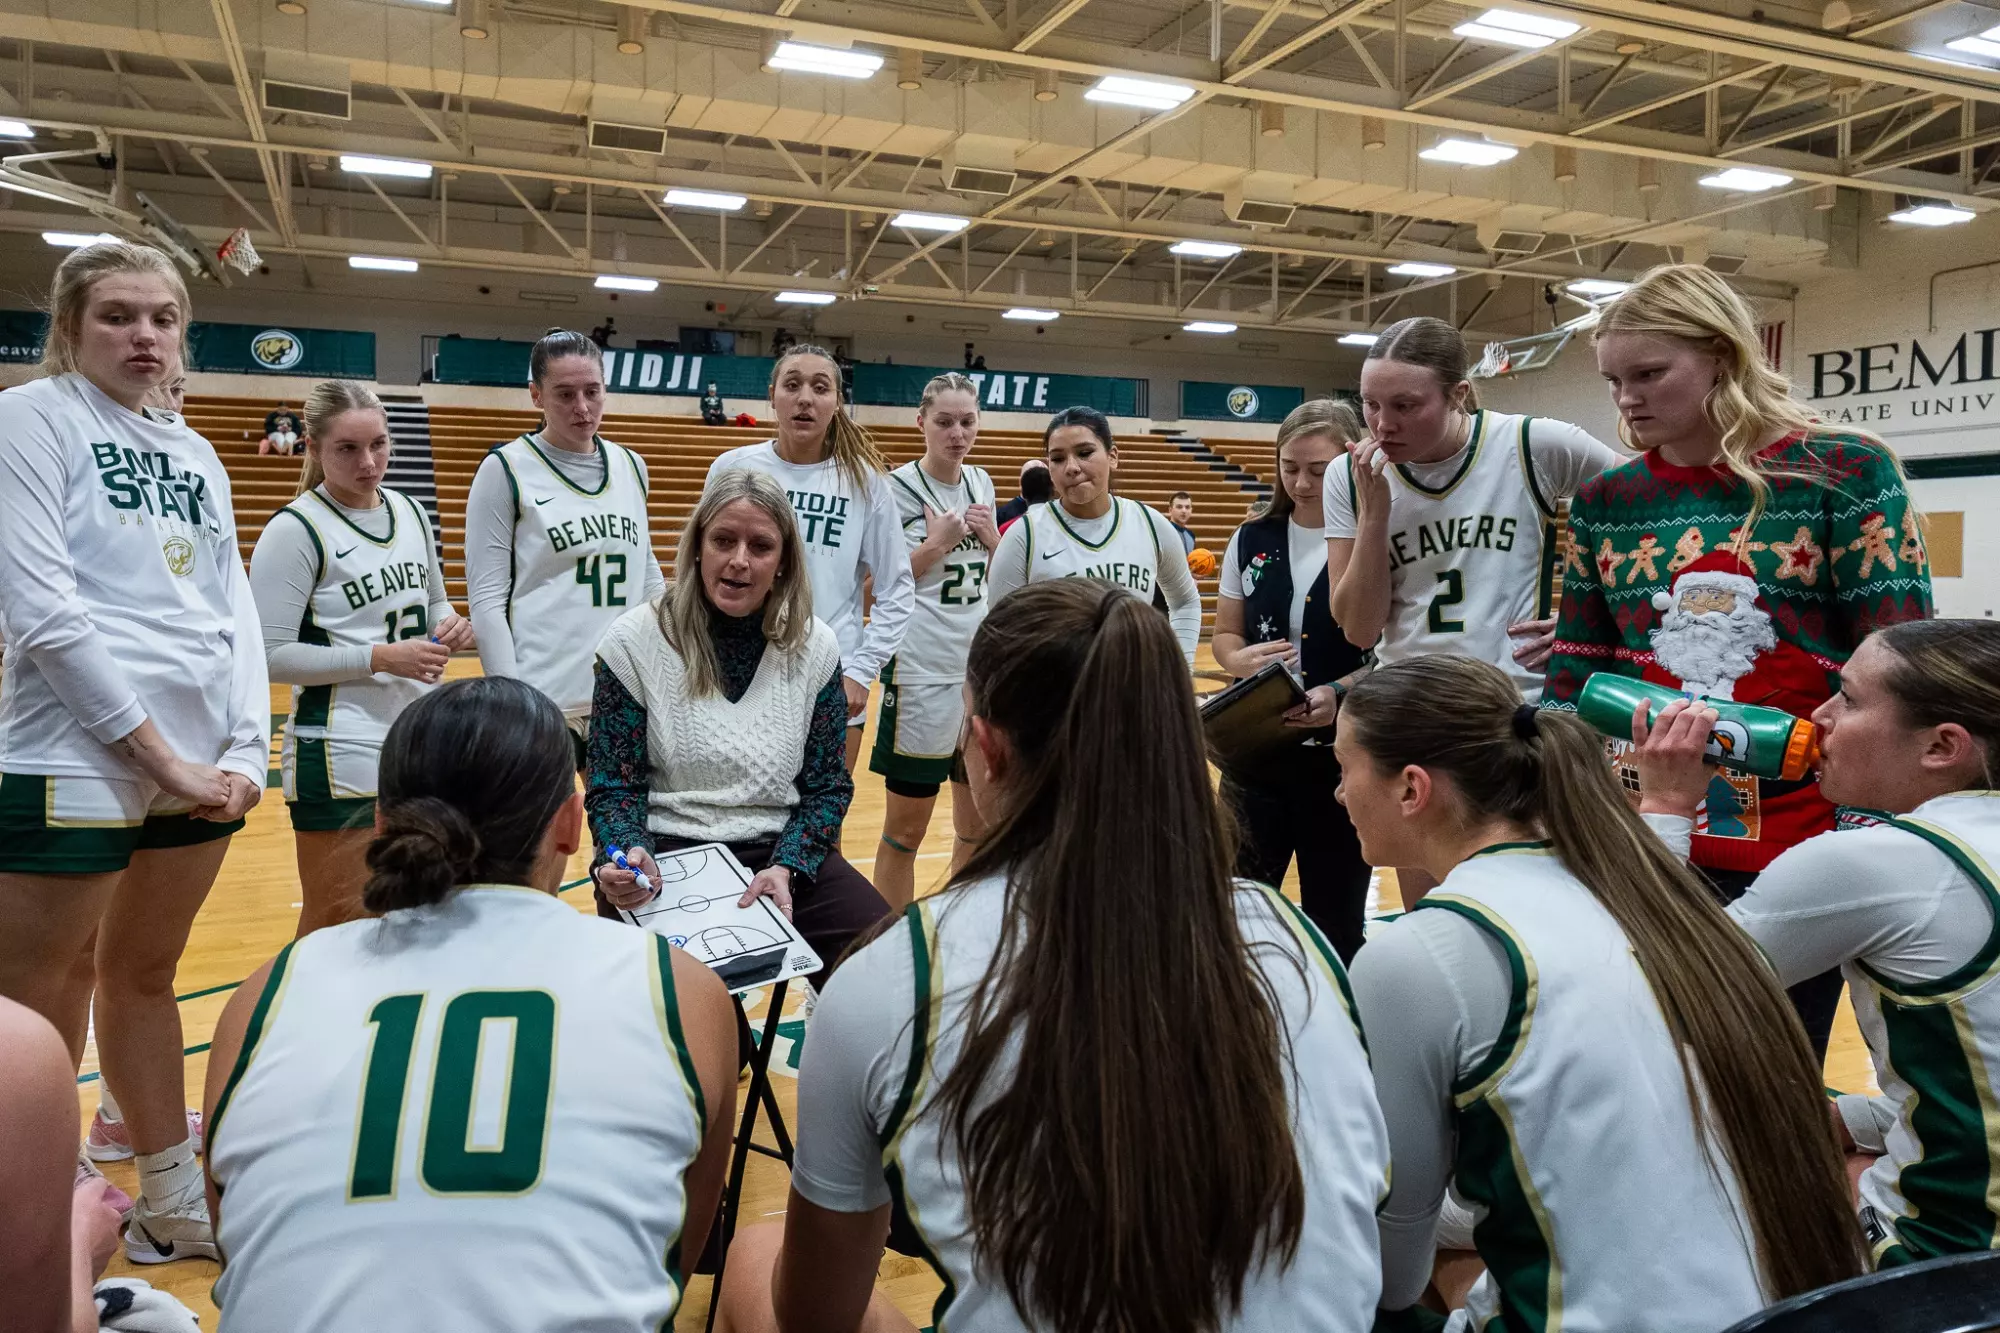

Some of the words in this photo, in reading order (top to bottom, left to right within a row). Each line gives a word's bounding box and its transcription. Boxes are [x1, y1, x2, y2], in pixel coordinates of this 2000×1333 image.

[1818, 403, 1892, 424] TATE
[1911, 393, 1995, 417] UNIV
[547, 514, 639, 553] BEAVERS
[341, 562, 430, 611] BEAVER
[575, 553, 627, 608] 42
[940, 561, 986, 605] 23
[1427, 568, 1465, 634] 2
[384, 604, 427, 645] 12
[345, 987, 561, 1205] 10
